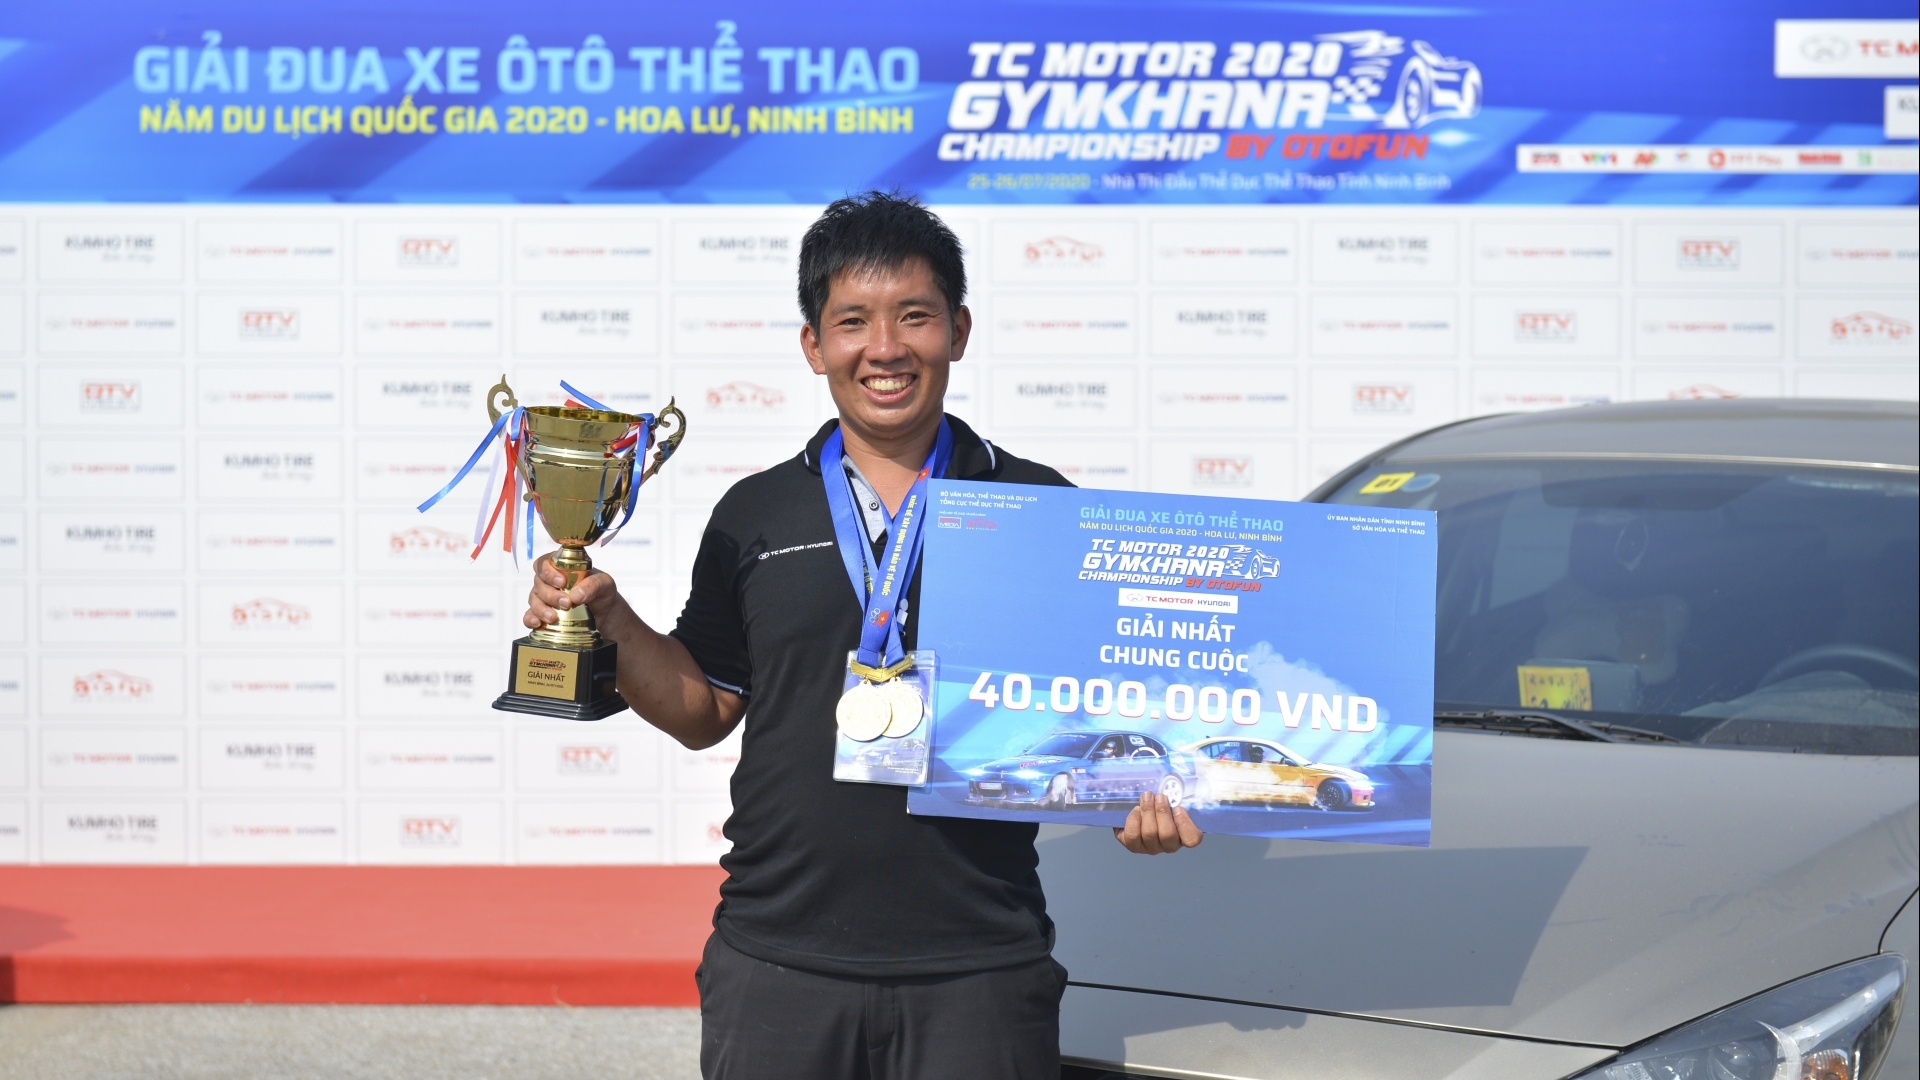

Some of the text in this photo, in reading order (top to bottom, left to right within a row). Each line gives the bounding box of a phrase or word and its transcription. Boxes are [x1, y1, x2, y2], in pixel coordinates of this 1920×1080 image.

[134, 20, 919, 94] GIẢI ĐUA XE ÔTÔ THỂ THAO
[968, 41, 1343, 78] TC MOTOR 2020
[140, 98, 213, 134] NĂM
[222, 105, 265, 134] DU
[274, 105, 343, 140] LỊCH
[350, 94, 438, 138] QUỐC
[444, 105, 499, 134] GIA
[505, 106, 589, 134] 2020
[616, 106, 685, 134] HOA
[748, 106, 827, 134] NINH
[836, 100, 913, 134] BÌNH
[948, 80, 1332, 130] GYMKHANA
[938, 132, 1428, 161] CHAMPIONSHIP BY OTOFUN
[1079, 521, 1099, 530] NĂM
[1102, 523, 1114, 531] DU
[1115, 524, 1134, 533] LỊCH
[1136, 523, 1157, 534] QUỐC
[1160, 527, 1174, 535] GIA
[1176, 528, 1197, 536] 2020
[1204, 530, 1222, 538] HOA
[1239, 533, 1259, 541] NINH
[1262, 532, 1282, 542] BÌNH
[1080, 504, 1284, 532] GIẢI ĐUA XE ÔTÔ THỂ THAO
[780, 545, 804, 554] MOTOR
[1092, 539, 1230, 559] TC MOTOR 2020
[1083, 552, 1225, 577] GYMKHANA
[1078, 570, 1261, 592] CHAMPIONSHIP BY OTOFUN
[1159, 596, 1193, 604] MOTOR
[1116, 613, 1235, 643] GIẢI NHẤT
[1100, 645, 1249, 676] CHUNG CUỘC
[528, 671, 565, 682] GIẢI NHẤT
[968, 671, 1378, 733] 40.000.000 VND
